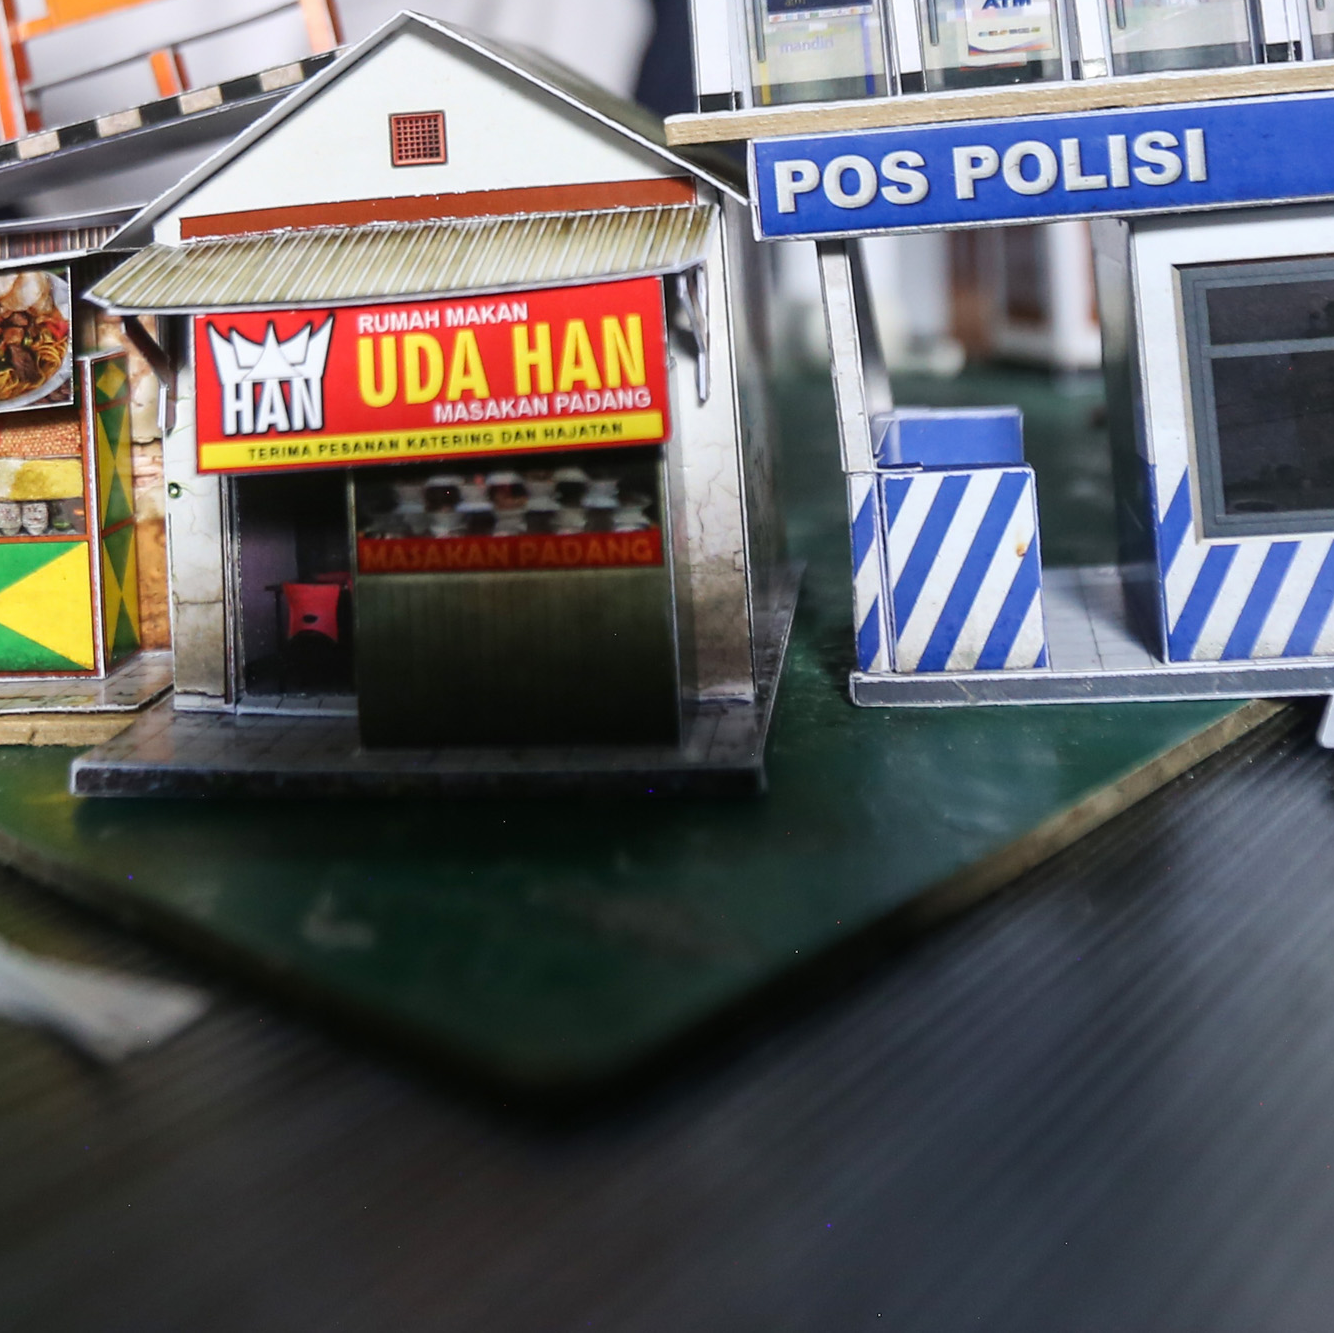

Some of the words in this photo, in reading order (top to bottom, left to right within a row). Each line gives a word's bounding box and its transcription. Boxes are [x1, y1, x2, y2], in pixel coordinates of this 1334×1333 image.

[773, 150, 930, 215] POS
[952, 128, 1207, 201] POLISI
[358, 311, 440, 335] RUMAH
[445, 301, 528, 328] MAKAN
[357, 327, 490, 409] UDA
[511, 313, 646, 396] HAN
[223, 377, 325, 437] HAN
[433, 395, 549, 424] MASAKAN
[555, 386, 652, 414] PADANG
[249, 442, 312, 461] TERIMA
[318, 436, 400, 457] PESANAN
[407, 429, 494, 451] KATERING
[501, 427, 536, 444] DAN
[544, 421, 623, 441] HAJATAN
[365, 540, 510, 569] MASAKAN
[520, 536, 653, 565] PADANG
